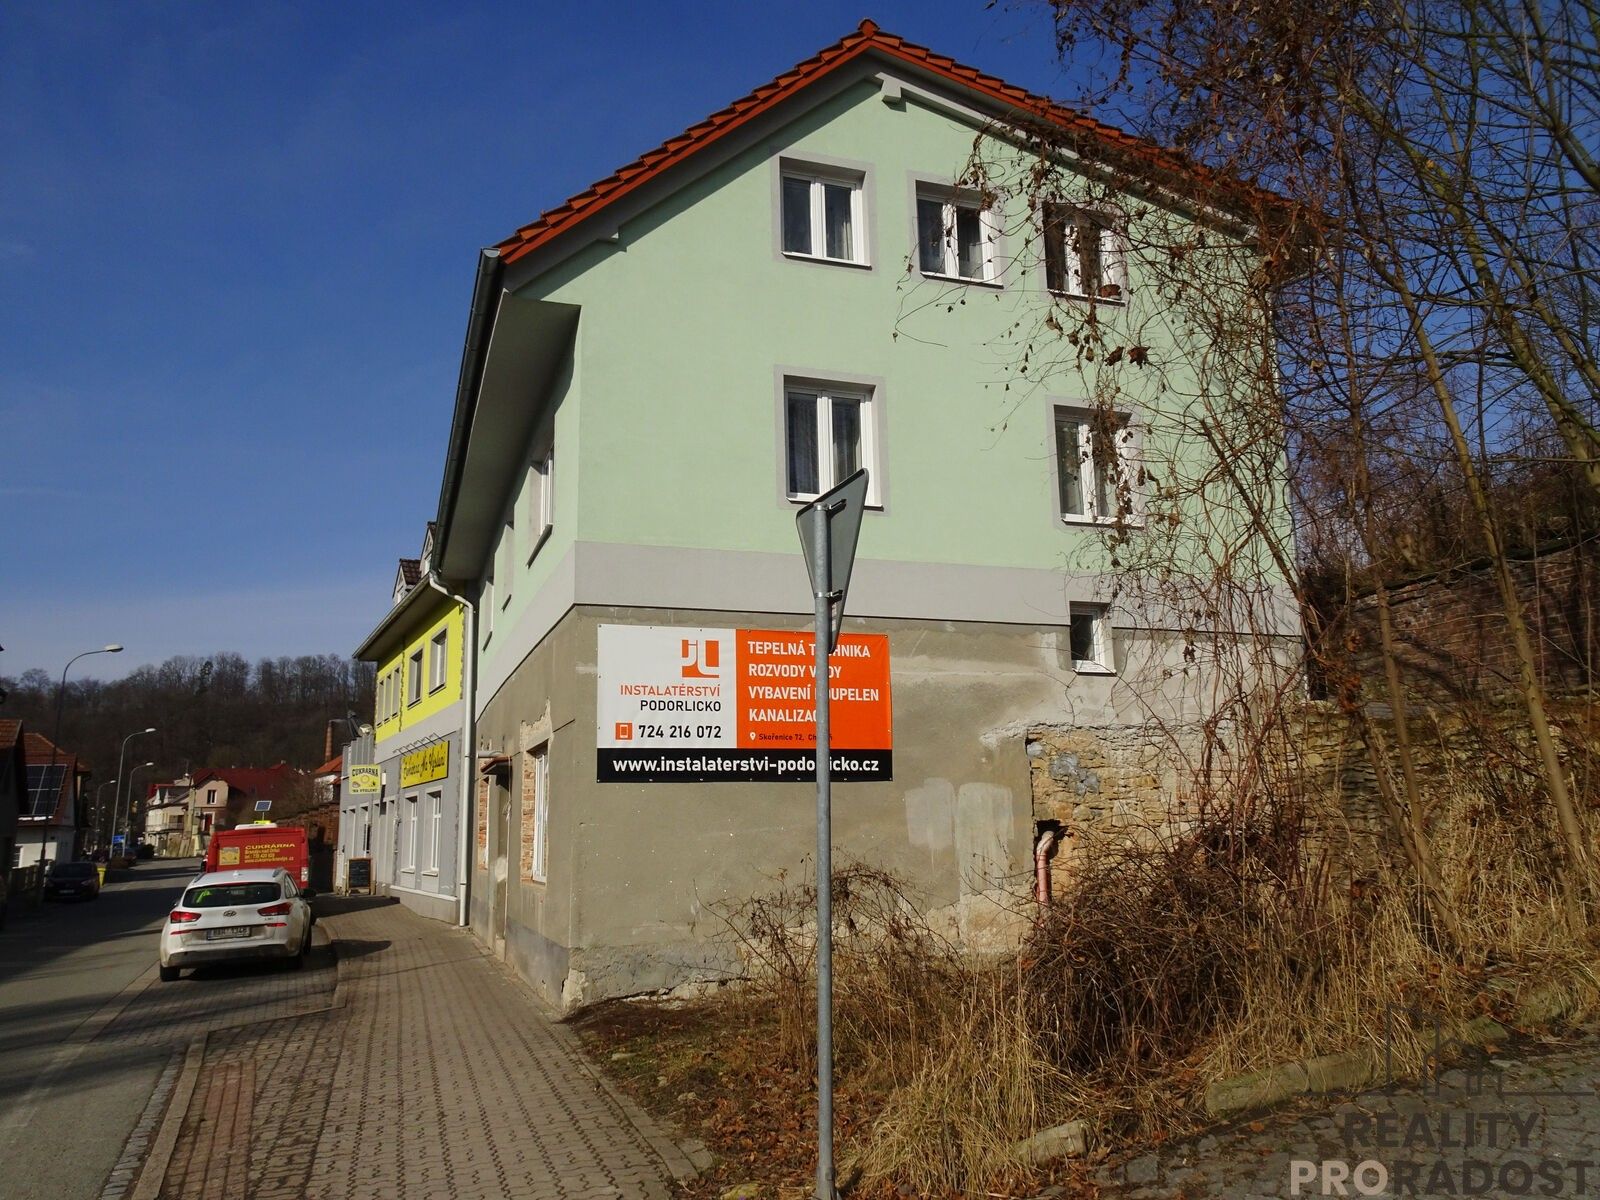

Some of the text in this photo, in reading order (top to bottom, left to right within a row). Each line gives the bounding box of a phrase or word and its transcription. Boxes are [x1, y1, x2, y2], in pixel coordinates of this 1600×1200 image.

[748, 641, 871, 658] TEPELNÁ THNIKA
[748, 664, 842, 679] ROZVODY VDY
[620, 684, 720, 697] INSTALATÉRSTVÍ
[748, 684, 879, 701] VYBAVENÍ UPELEN
[640, 700, 721, 712] PODORLICKO
[638, 725, 722, 738] 724 216 072
[613, 756, 879, 775] www.instalaterstvi-podoicko.cz
